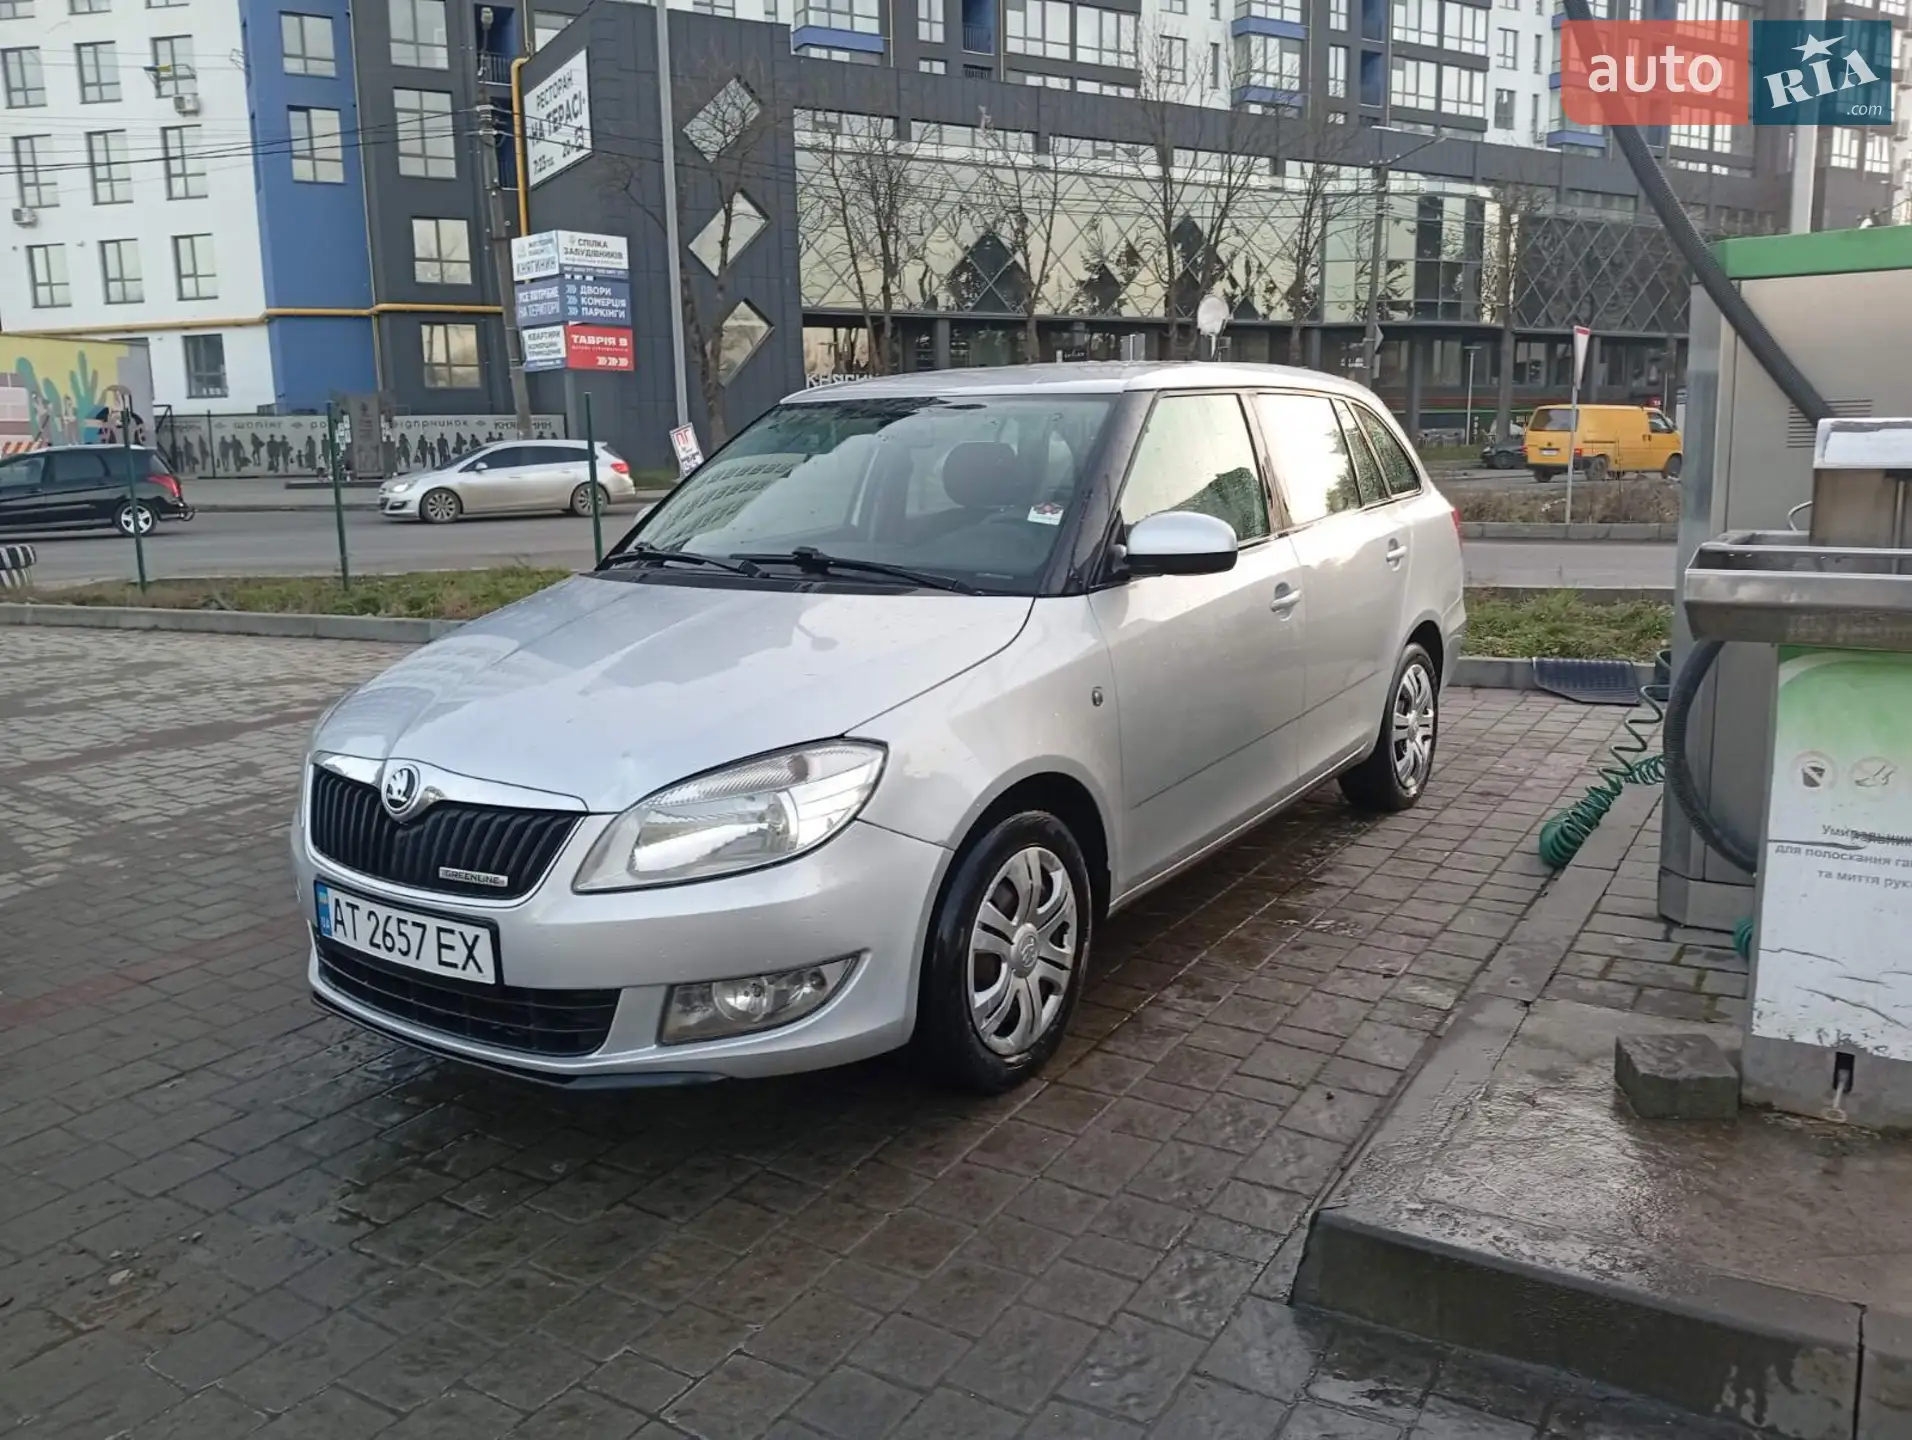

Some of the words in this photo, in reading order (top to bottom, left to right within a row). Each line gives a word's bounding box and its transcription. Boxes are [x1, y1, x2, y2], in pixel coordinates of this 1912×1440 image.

[536, 68, 573, 111] РЕСТОРАН
[577, 238, 608, 248] СПІЛКА
[563, 246, 624, 259] ЗАБУДІВНИКІВ
[580, 285, 612, 296] ДВОРИ
[580, 296, 627, 309] КОМЕРЦІЯ
[581, 306, 626, 319] ПАРКІНГИ
[571, 334, 617, 346] ТАВРІЯ
[618, 337, 628, 346] В
[1774, 844, 1802, 856] для
[1804, 846, 1892, 866] полоскання
[444, 870, 501, 886] GREENLINE
[1815, 869, 1834, 879] та
[1836, 872, 1881, 886] миття
[1884, 877, 1912, 890] рук
[333, 897, 360, 942] AT
[367, 909, 428, 961] 2657
[435, 925, 484, 975] EX
